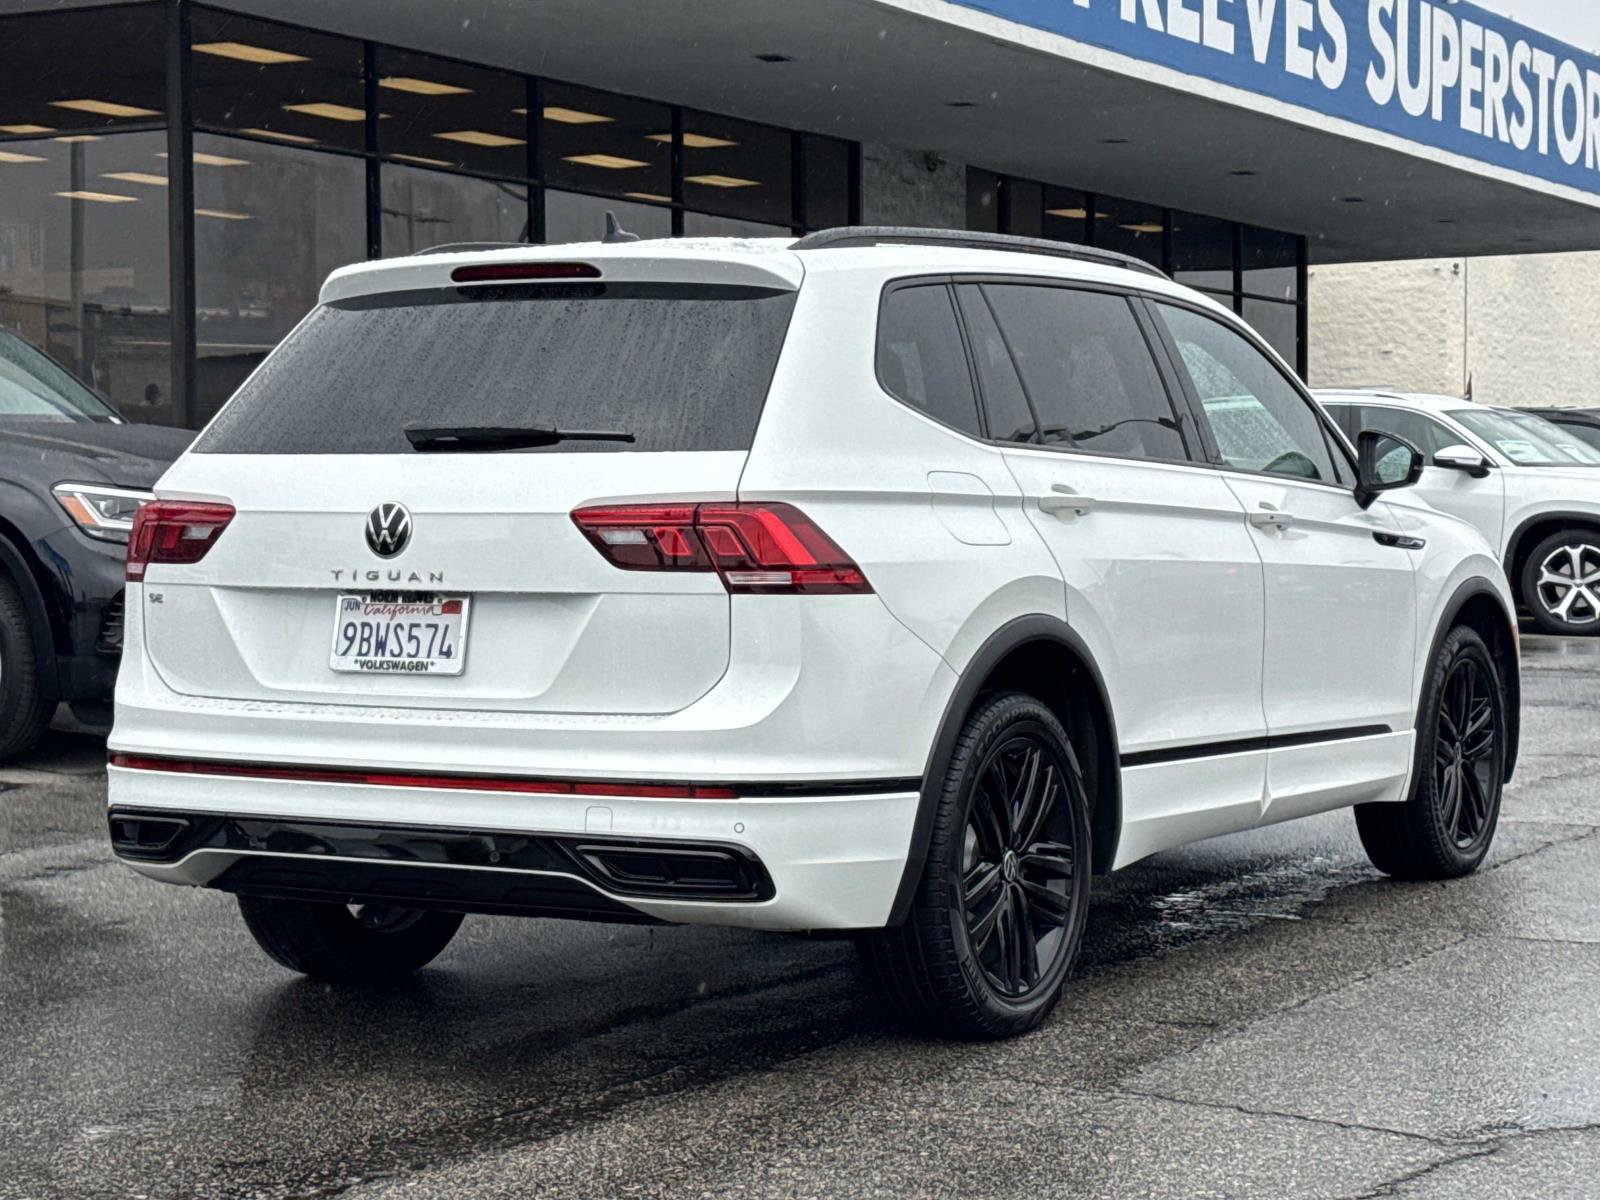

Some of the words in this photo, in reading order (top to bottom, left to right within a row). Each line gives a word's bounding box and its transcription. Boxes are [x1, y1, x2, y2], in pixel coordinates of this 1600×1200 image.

[1120, 0, 1348, 90] VES
[331, 570, 443, 583] TIGUAN
[149, 593, 164, 604] SE
[344, 600, 361, 612] JUN
[364, 604, 434, 621] California
[340, 621, 453, 659] 9BWS574
[359, 659, 430, 672] VOLKSWAGEN
